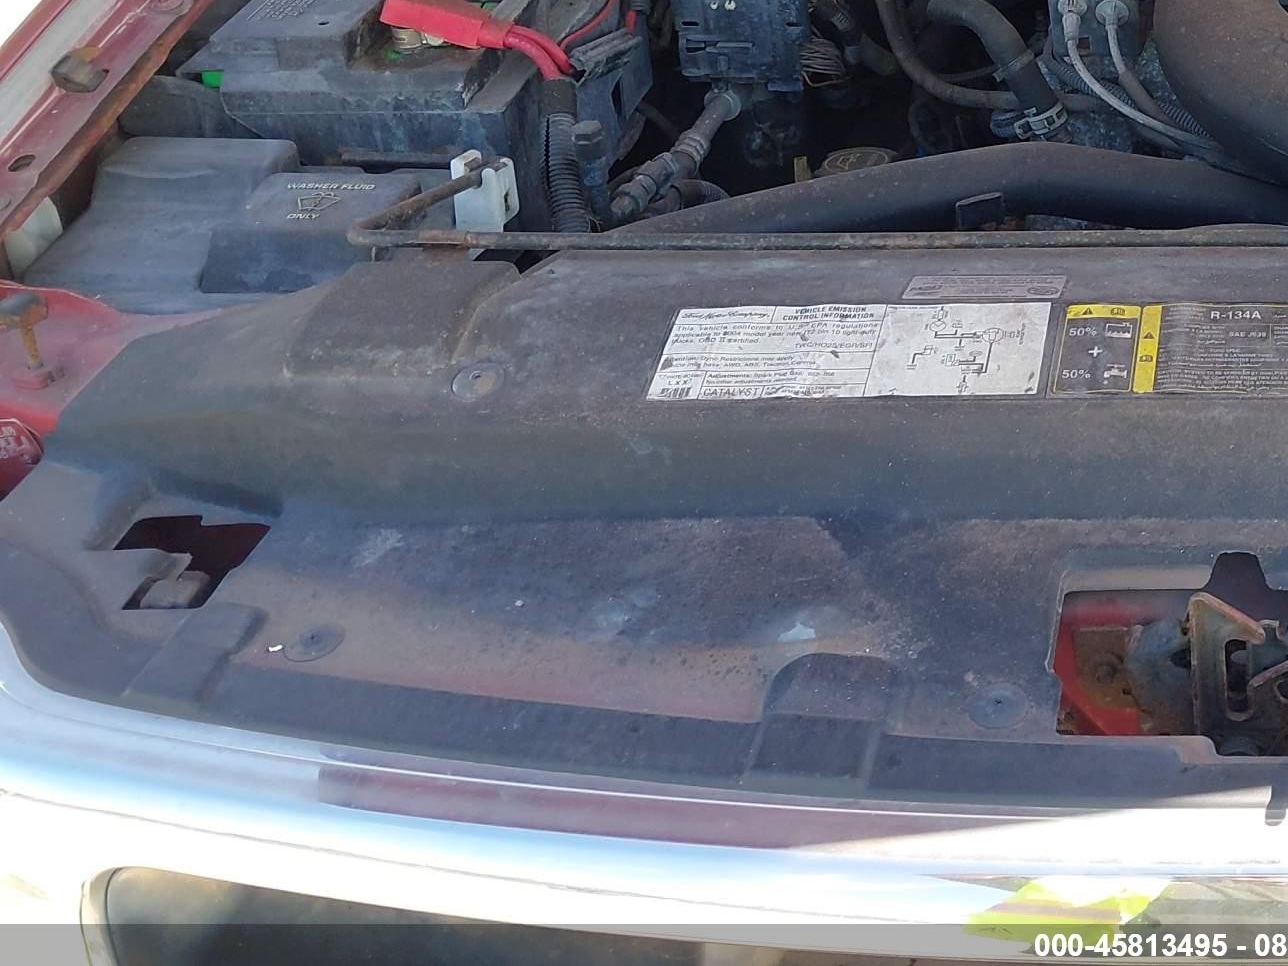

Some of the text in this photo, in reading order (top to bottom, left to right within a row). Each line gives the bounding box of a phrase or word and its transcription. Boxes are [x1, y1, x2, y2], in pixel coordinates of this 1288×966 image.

[287, 182, 339, 190] WASHER
[795, 306, 826, 314] VEHICLE
[1210, 311, 1262, 320] R-134A
[1068, 327, 1098, 337] 50%
[1061, 369, 1092, 379] 50%
[703, 387, 760, 396] CATALYST
